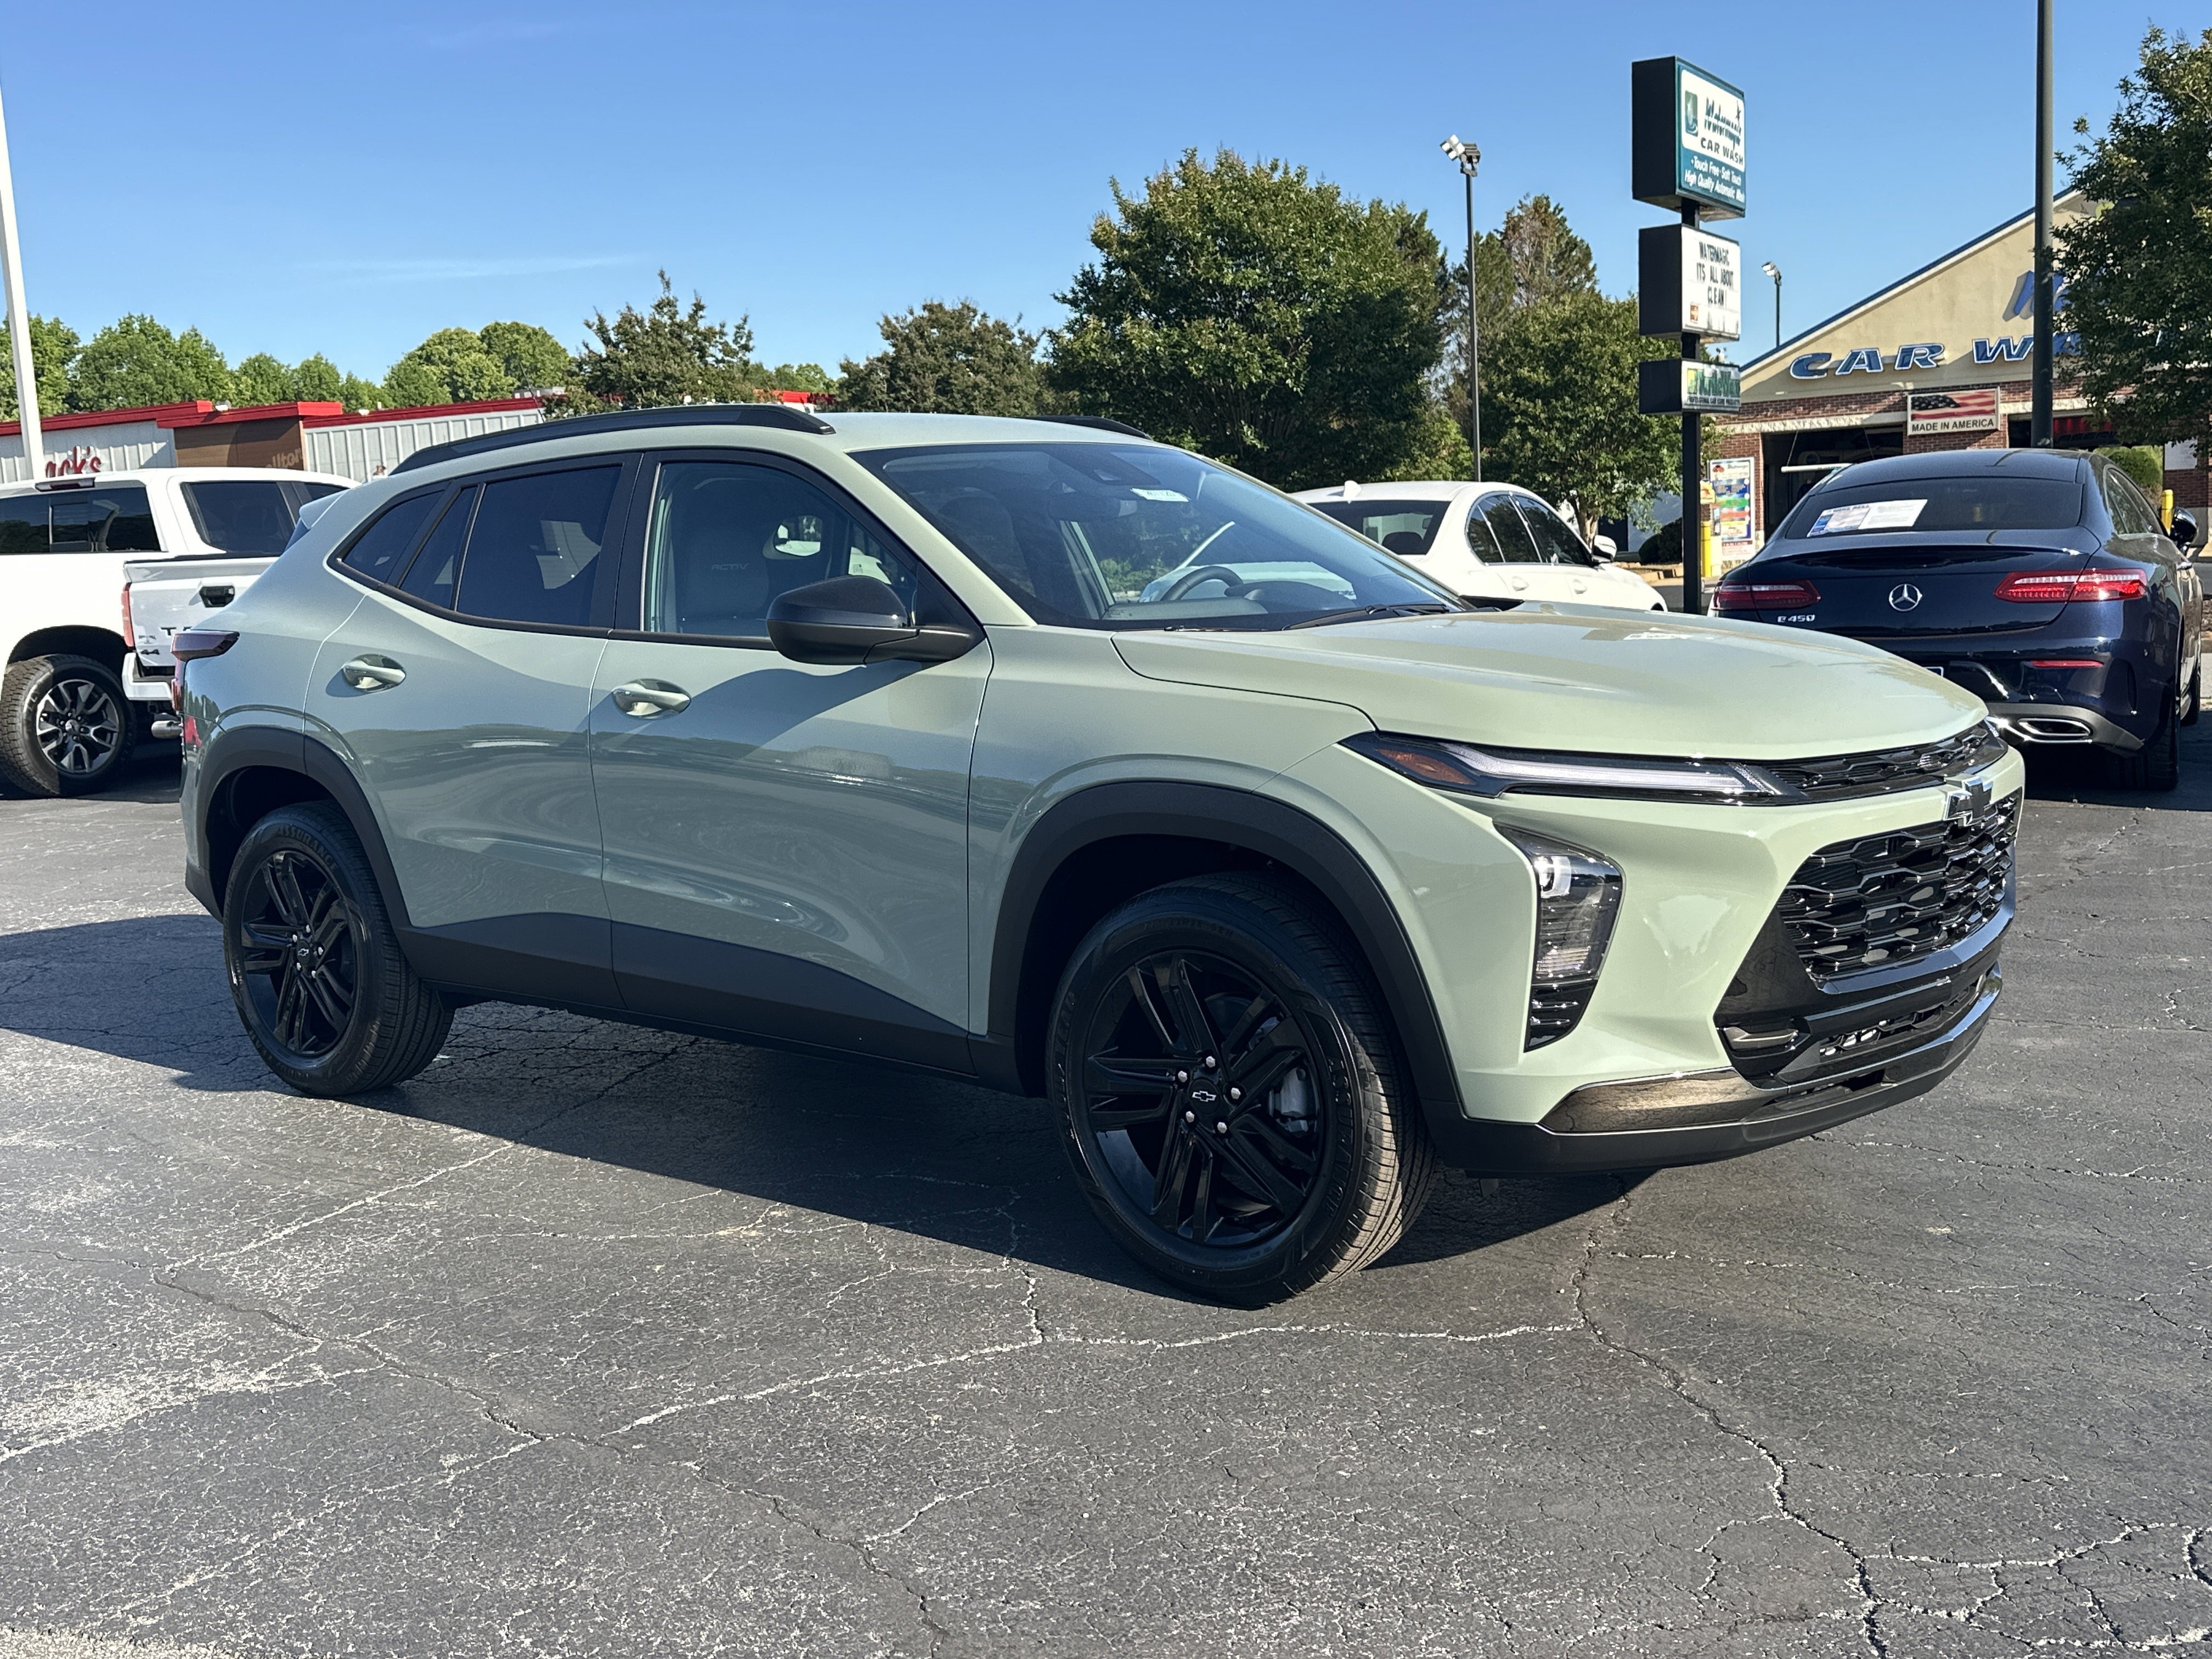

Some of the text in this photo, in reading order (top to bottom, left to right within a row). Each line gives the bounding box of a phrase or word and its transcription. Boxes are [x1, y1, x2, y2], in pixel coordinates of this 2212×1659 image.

[1700, 137, 1743, 165] CAR WASH
[1694, 156, 1708, 172] Touch
[1685, 169, 1696, 187] High
[1697, 173, 1714, 193] Quality
[1699, 241, 1729, 266] WATERMAGIC
[1697, 262, 1734, 288] ITS ALL ABOUT
[1790, 342, 1945, 380] CAR
[1912, 418, 1994, 432] MADE IN AMERICA
[278, 825, 338, 872] ASSURANCE
